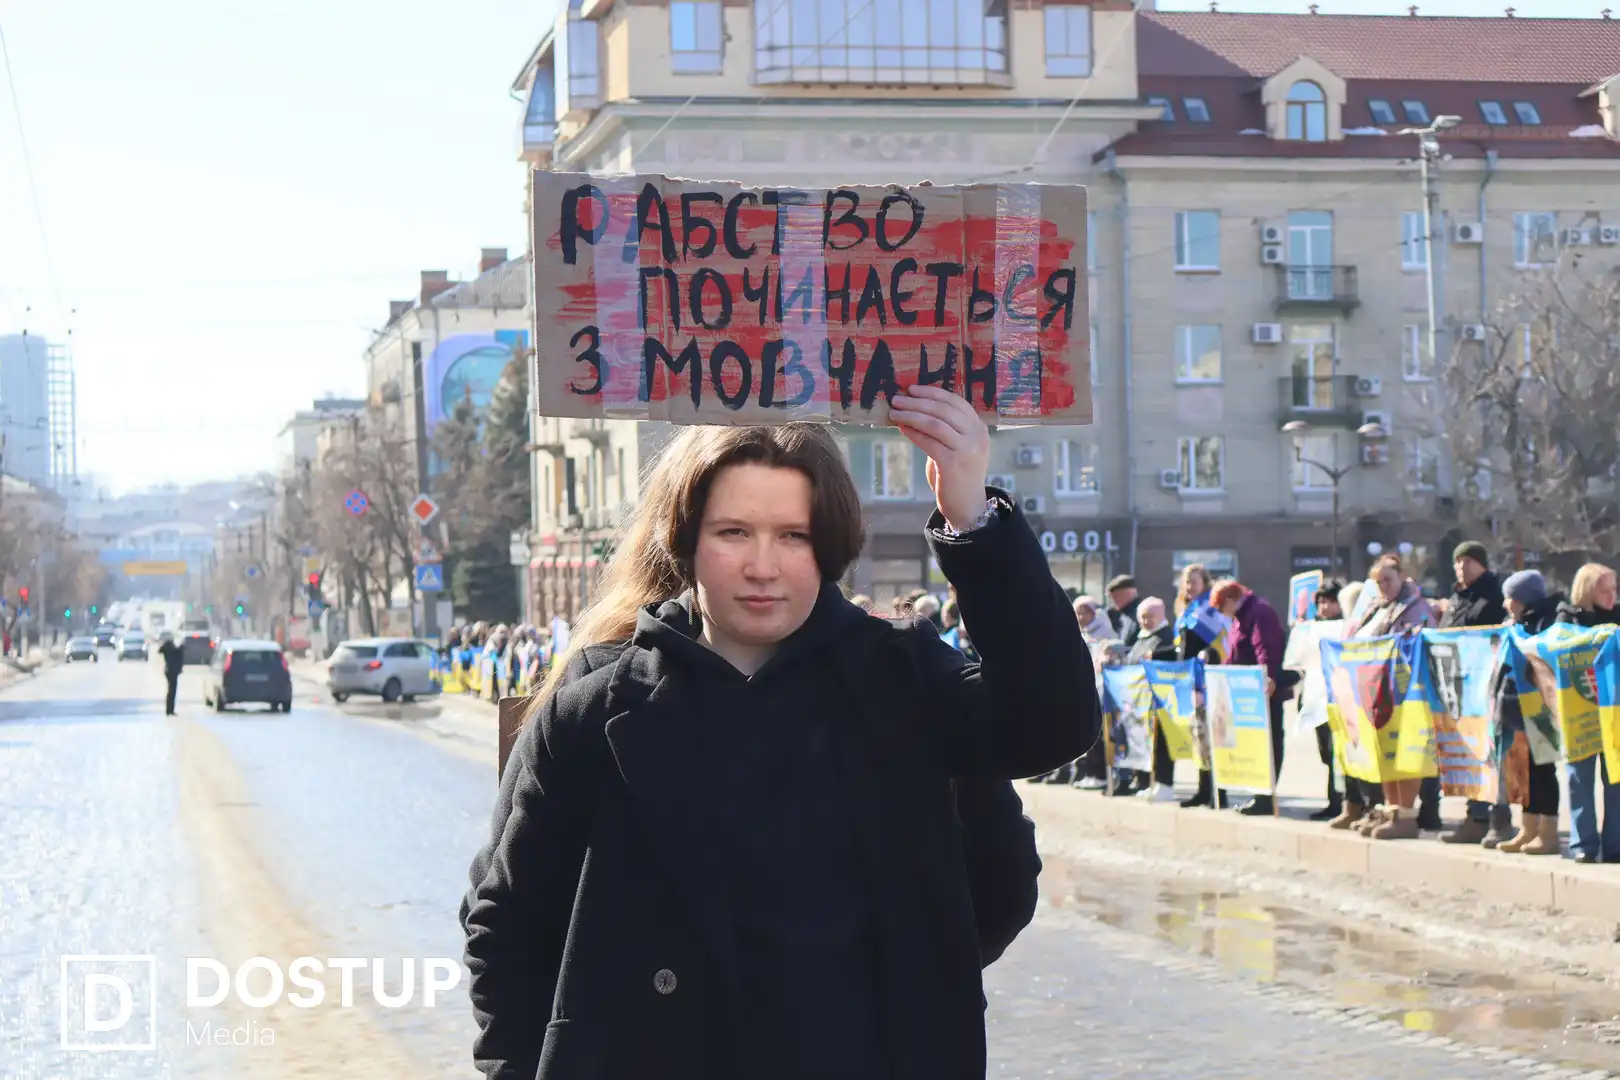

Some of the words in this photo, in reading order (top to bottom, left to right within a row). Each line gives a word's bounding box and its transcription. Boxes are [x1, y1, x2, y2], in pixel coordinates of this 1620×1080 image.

[560, 183, 928, 265] РАБСТВО
[637, 257, 1077, 332] ПОЧИНАЄТЬСЯ
[569, 326, 609, 395] З
[637, 334, 1042, 411] МОВЧАННЯ
